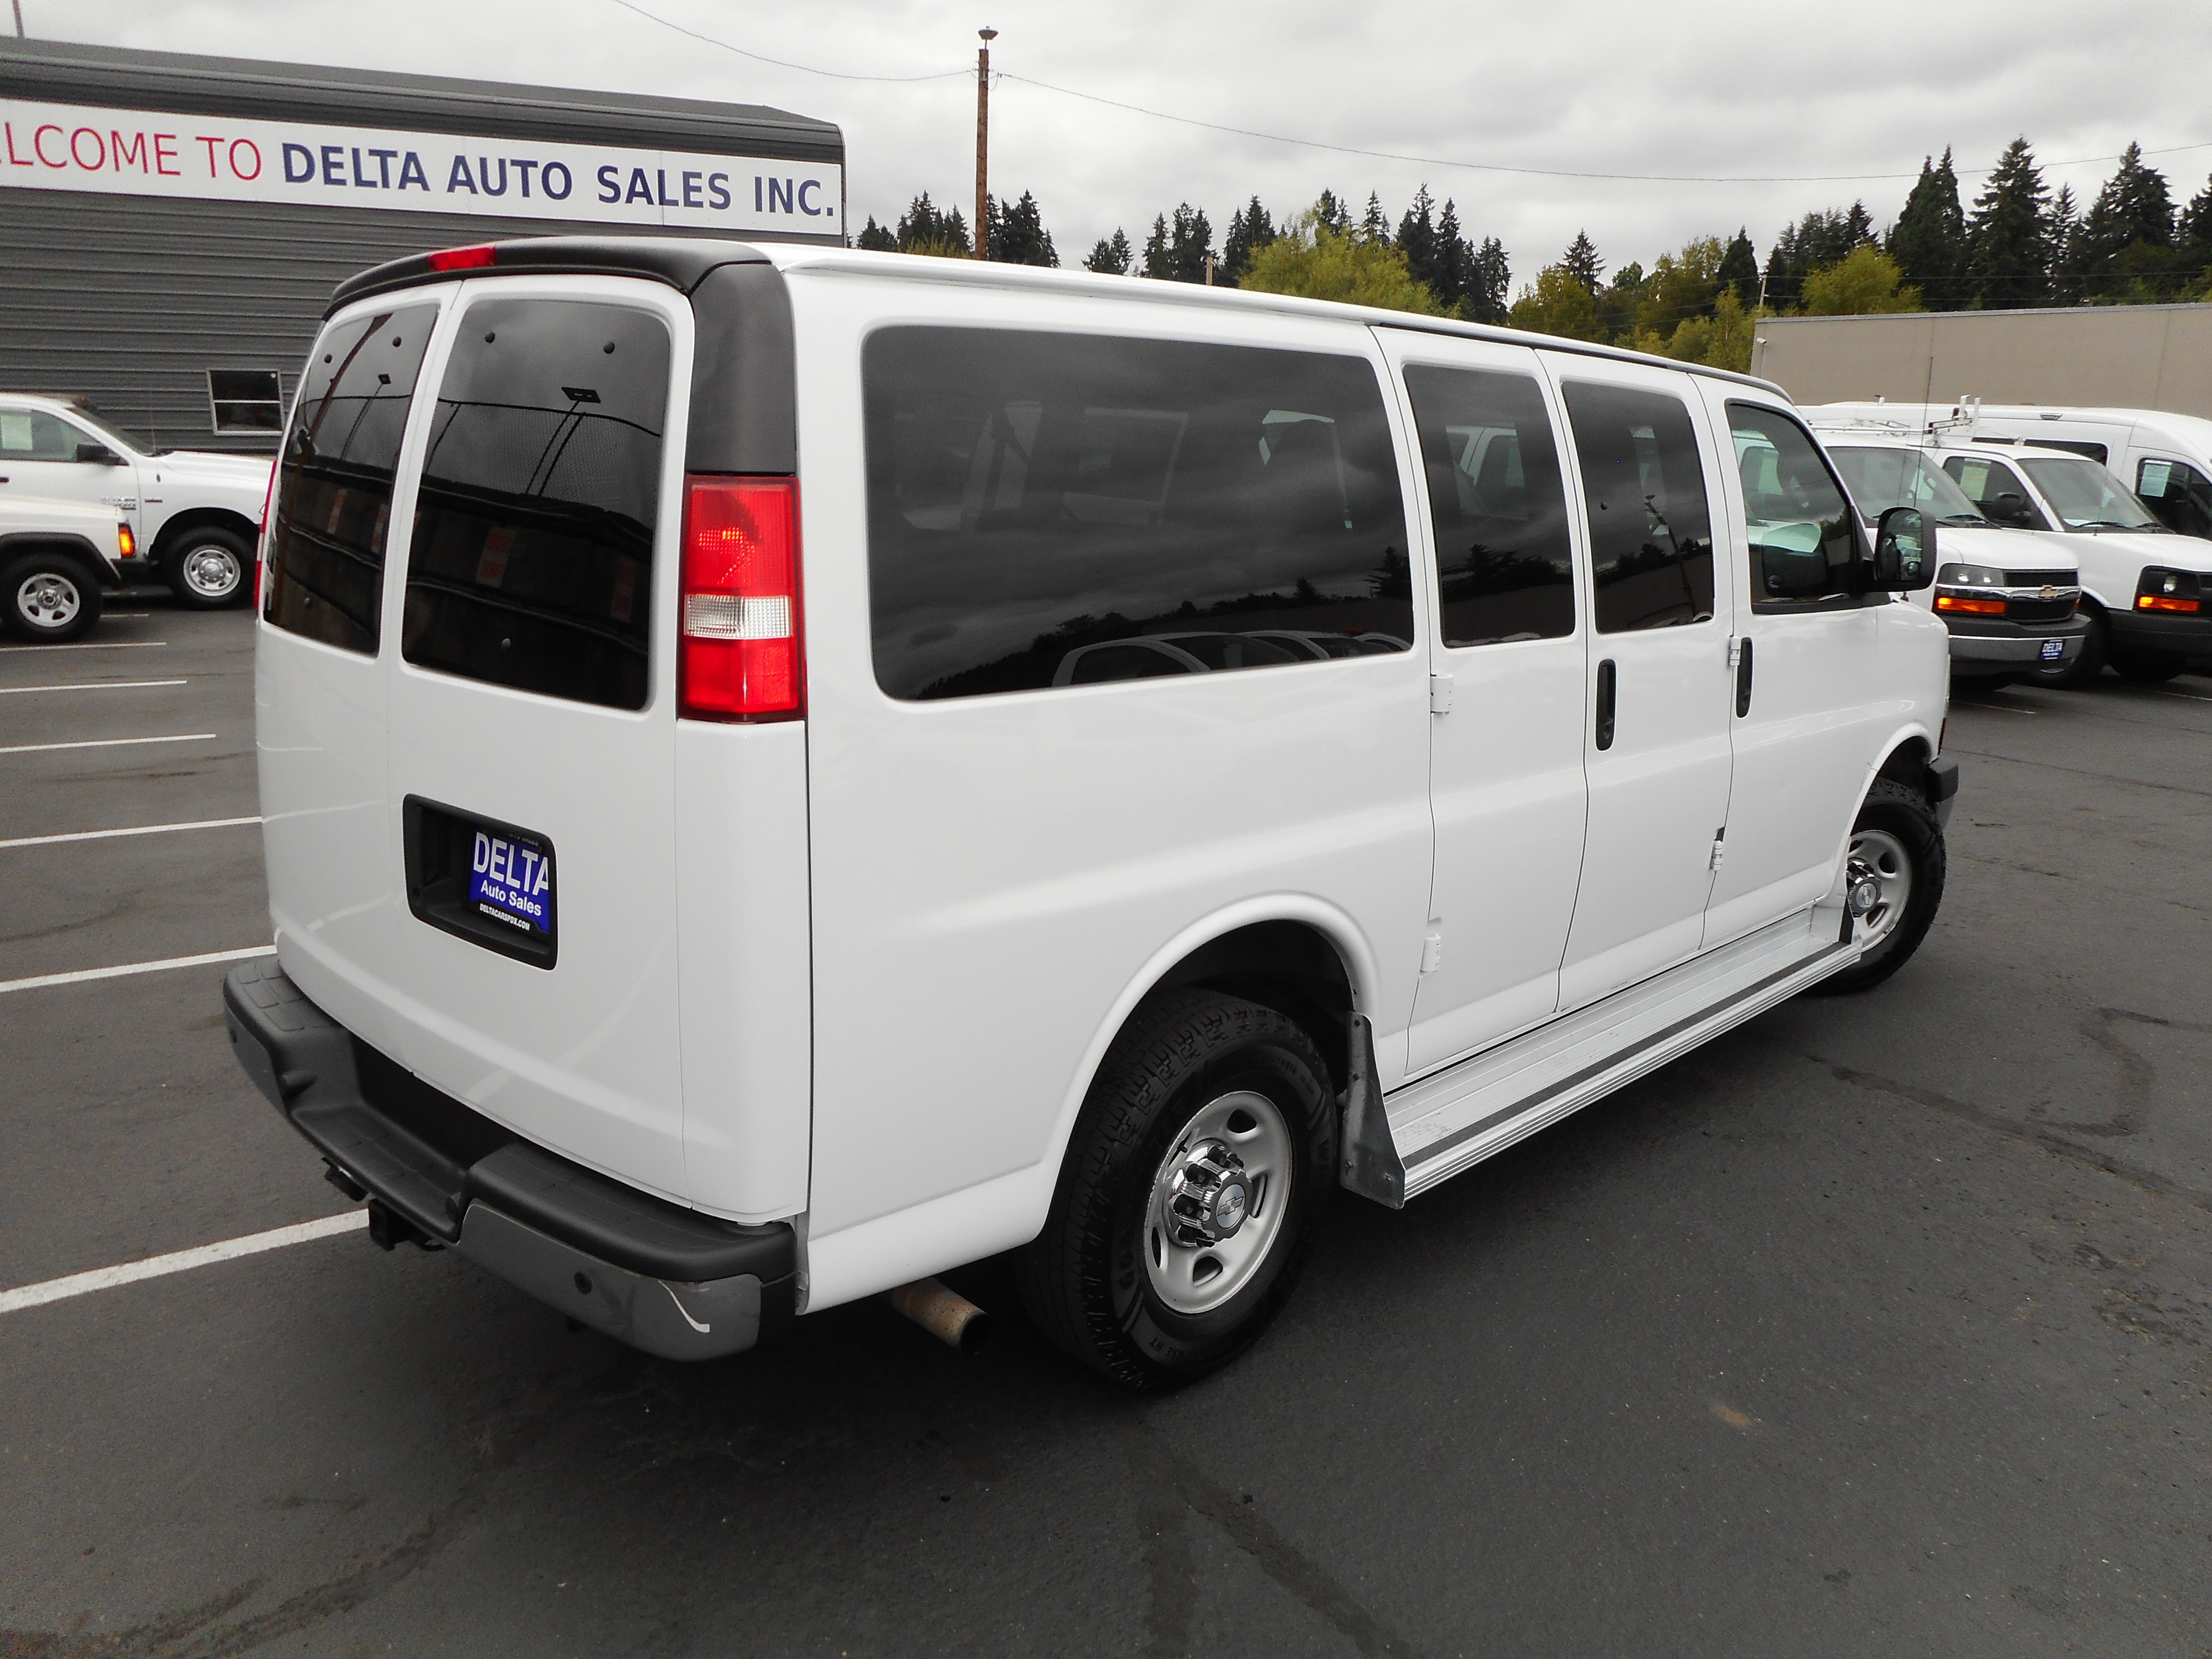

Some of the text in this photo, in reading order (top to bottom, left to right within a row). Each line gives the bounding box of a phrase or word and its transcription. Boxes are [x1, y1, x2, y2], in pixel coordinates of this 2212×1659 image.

[0, 123, 833, 215] LCOME TO DELTA AUTO SALES INC.
[2042, 643, 2063, 652] DELTA
[474, 832, 548, 896] DELTA
[481, 880, 541, 916] Auto Sales
